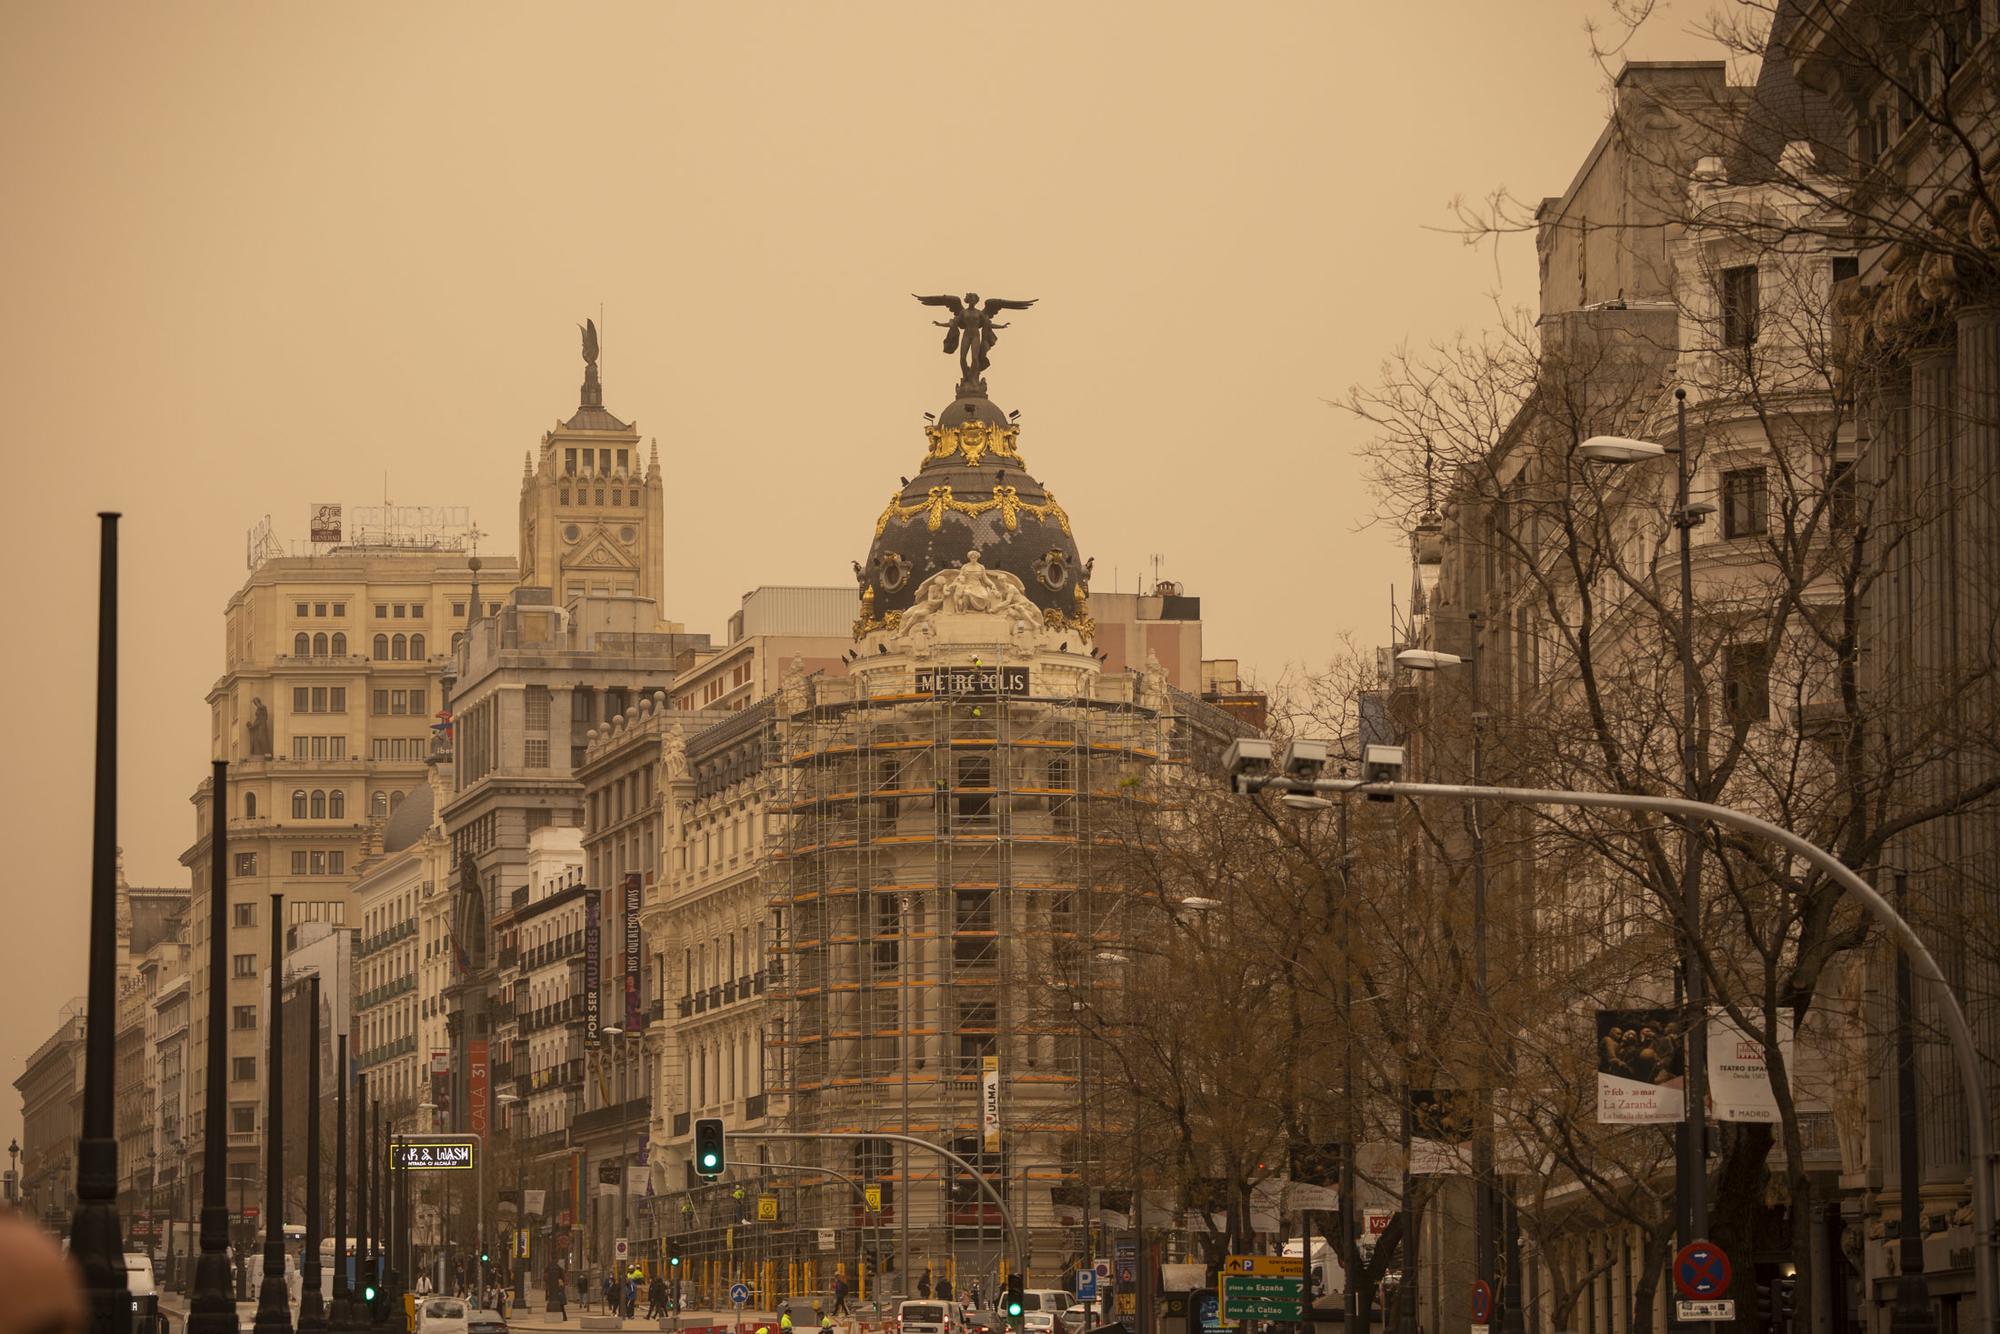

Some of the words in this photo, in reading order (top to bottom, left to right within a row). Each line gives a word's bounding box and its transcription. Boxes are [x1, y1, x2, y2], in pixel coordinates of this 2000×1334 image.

[627, 889, 639, 911] VIVAS
[627, 913, 639, 954] QUEREMOS
[587, 928, 598, 989] MUJERES
[627, 956, 639, 972] NOS
[587, 991, 598, 1011] SER
[587, 1012, 598, 1039] POR
[472, 1063, 486, 1078] 31
[988, 1083, 996, 1112] ULMA
[1603, 1100, 1616, 1109] La
[1617, 1099, 1657, 1109] Zaranda
[1738, 1110, 1770, 1118] MADRID
[421, 1147, 433, 1160] &
[436, 1147, 469, 1160] WASH
[1078, 1271, 1092, 1291] P
[1255, 1283, 1284, 1292] España
[1257, 1305, 1282, 1314] Callao
